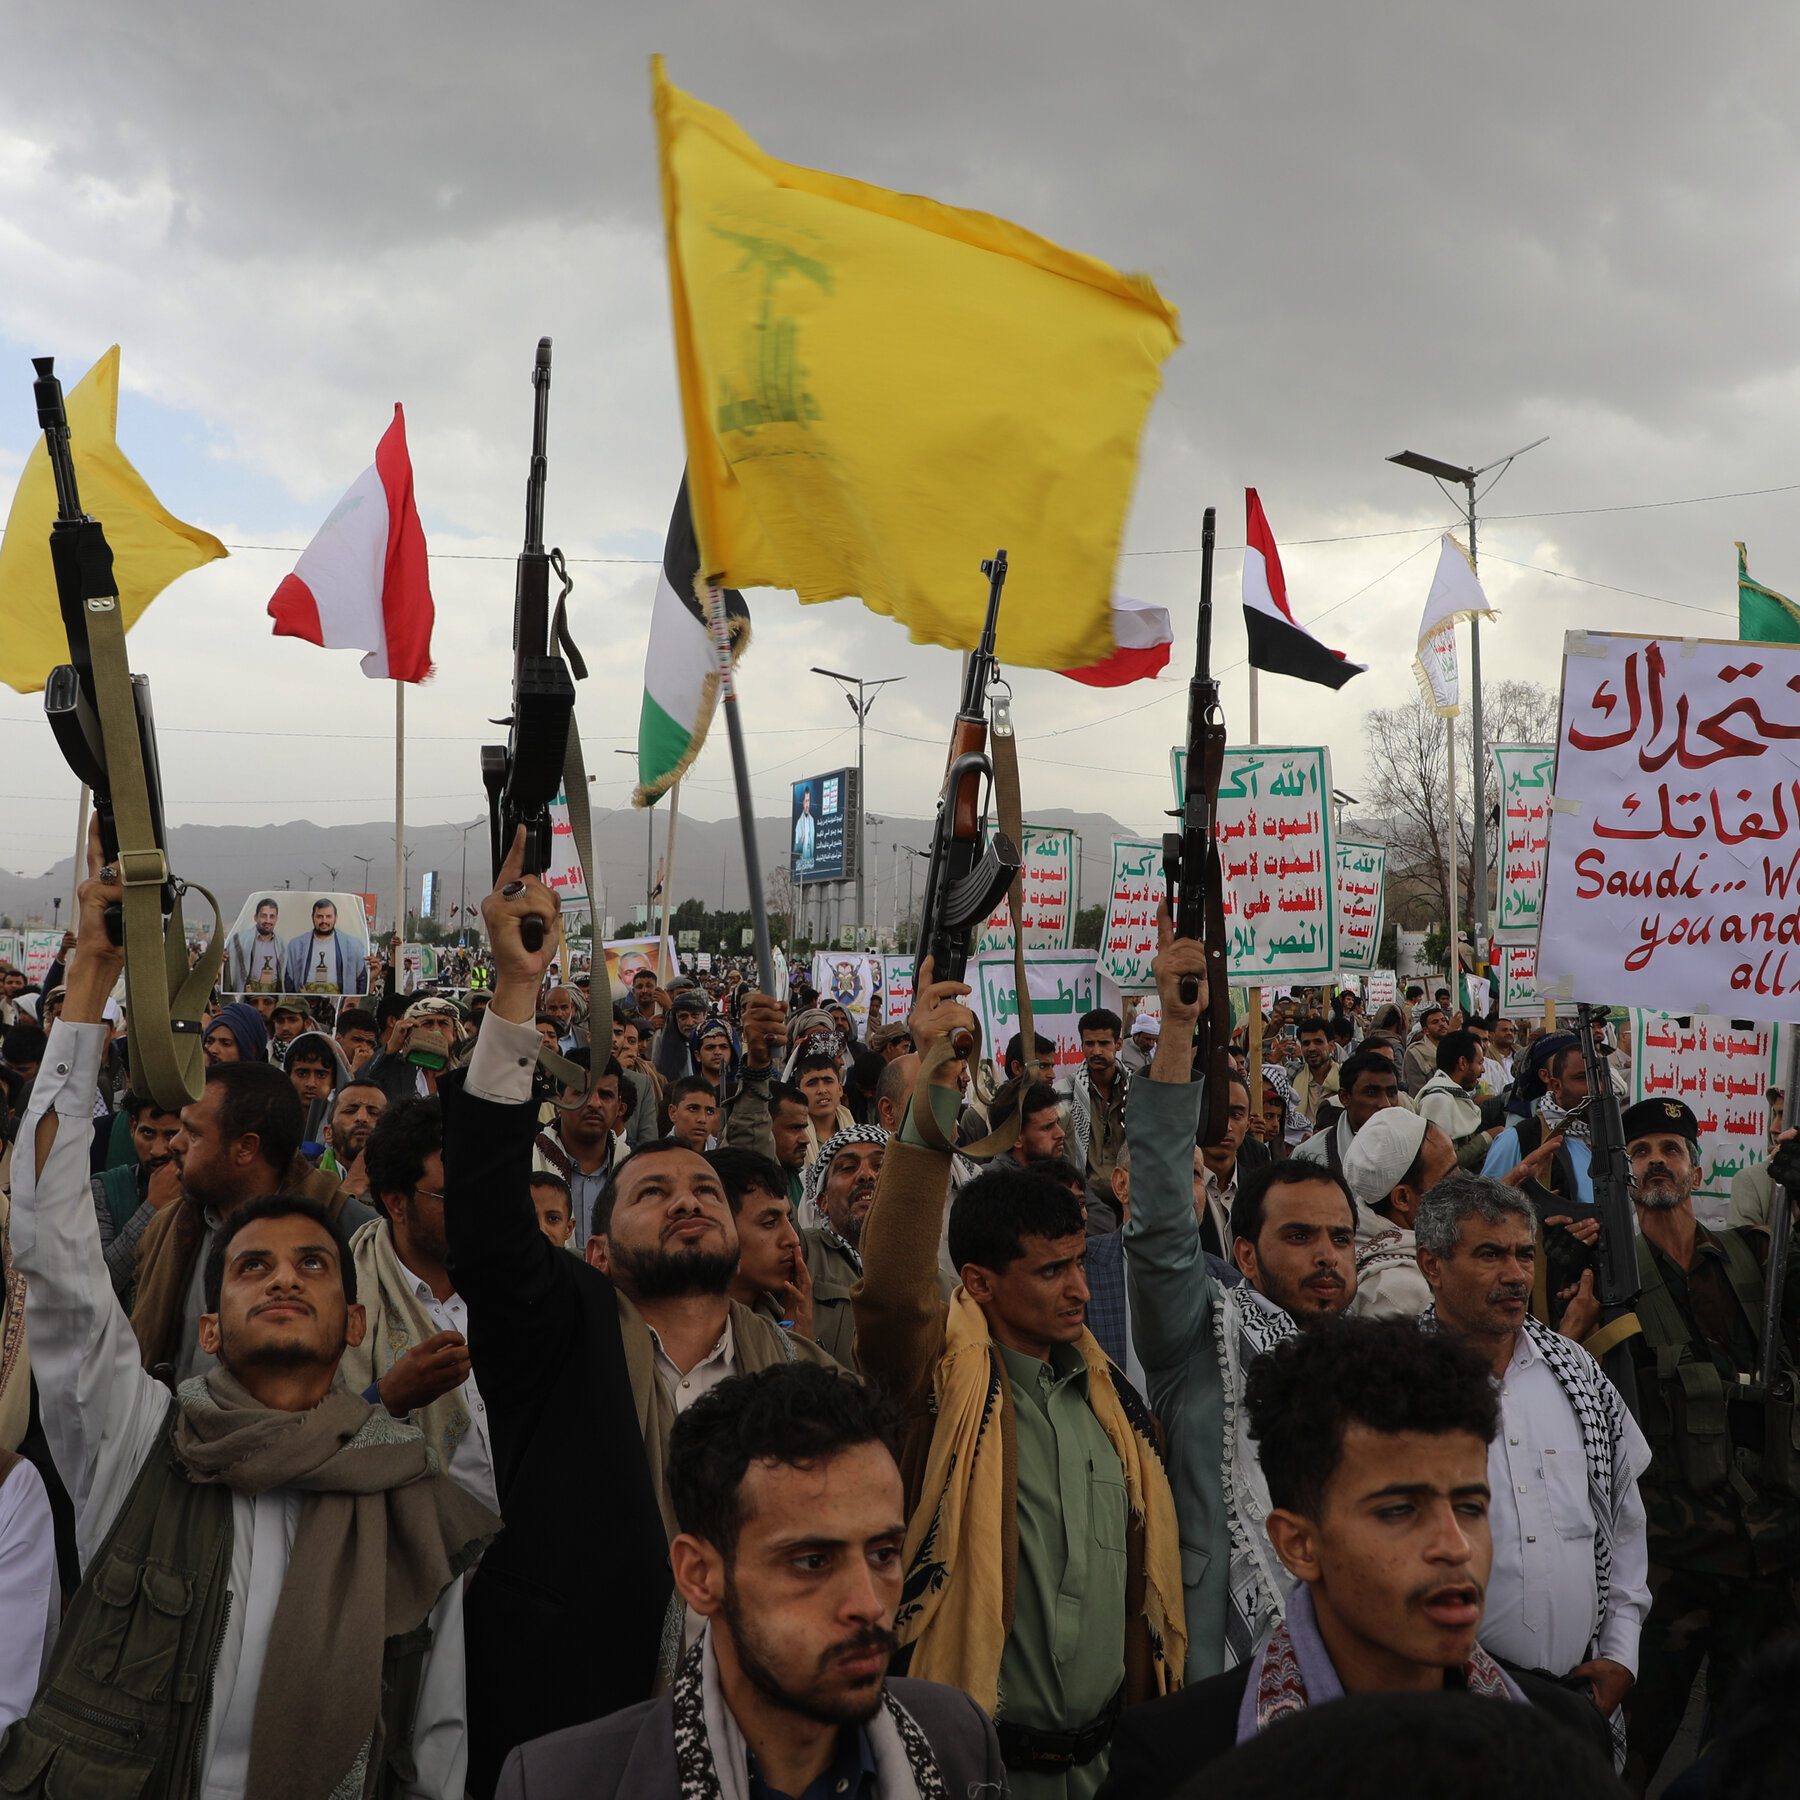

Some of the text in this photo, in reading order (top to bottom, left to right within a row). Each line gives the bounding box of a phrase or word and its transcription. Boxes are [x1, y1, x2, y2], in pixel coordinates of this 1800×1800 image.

[1269, 761, 1318, 797] الله
[1263, 810, 1319, 841] الموت
[1030, 866, 1067, 883] الموت
[1116, 850, 1156, 883] أكبر
[1221, 851, 1258, 883] لإسرا
[1264, 849, 1321, 880] الموت
[1505, 860, 1542, 884] اليهود
[1763, 848, 1800, 900] W
[1030, 890, 1067, 908] الموت
[1243, 889, 1270, 920] على
[1278, 886, 1323, 912] اللعنة
[1263, 920, 1324, 965] النصر
[1509, 965, 1534, 980] ليهود
[1730, 949, 1787, 997] all
[1646, 1021, 1768, 1059] الموت لأمريكا
[1713, 1072, 1765, 1099] الموت
[1724, 1108, 1764, 1136] اللعنة
